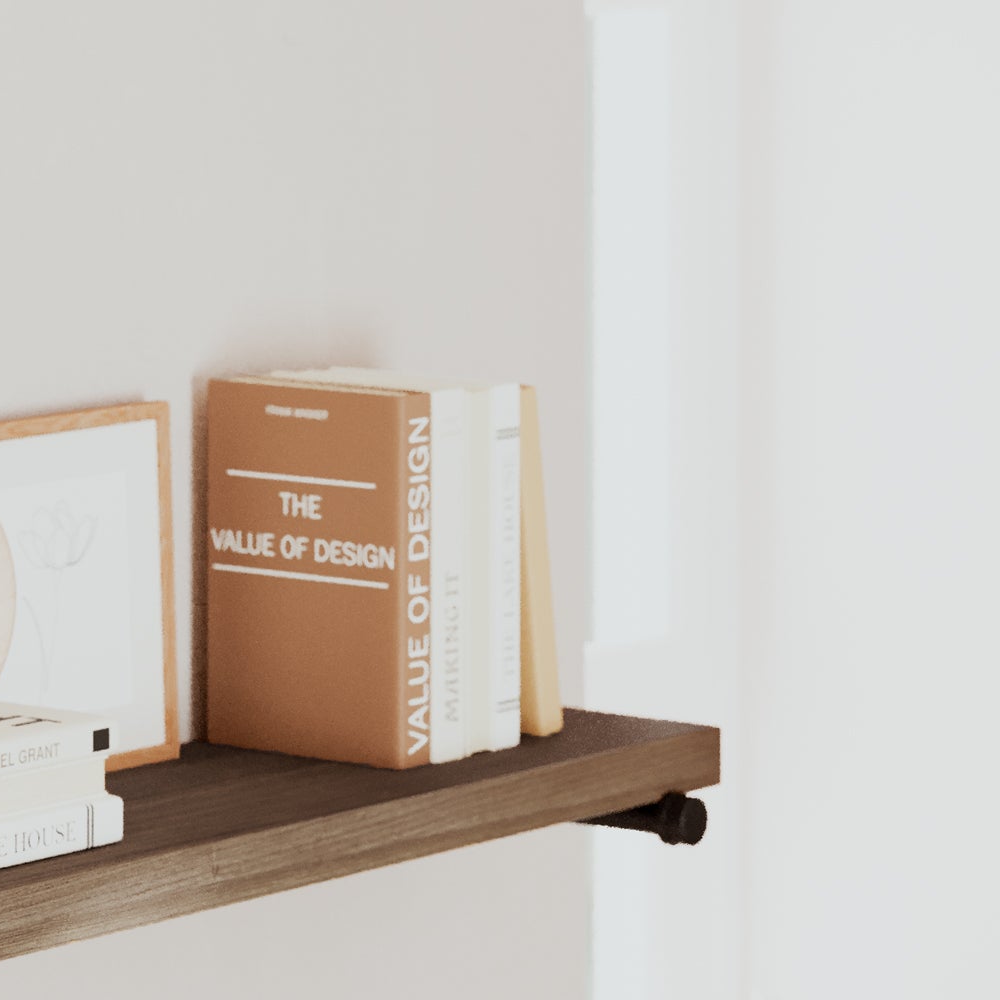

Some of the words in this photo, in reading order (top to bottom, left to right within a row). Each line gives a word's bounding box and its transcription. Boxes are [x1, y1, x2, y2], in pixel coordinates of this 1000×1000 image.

[278, 491, 322, 520] THE
[408, 416, 430, 562] DESIGN
[210, 528, 275, 557] VALUE
[280, 534, 309, 560] OF
[314, 538, 395, 570] DESIGN
[408, 573, 430, 625] OF
[444, 604, 460, 723] MAKING
[408, 633, 430, 755] VALUE
[18, 743, 61, 765] GRANT
[14, 820, 77, 854] HOUSE
